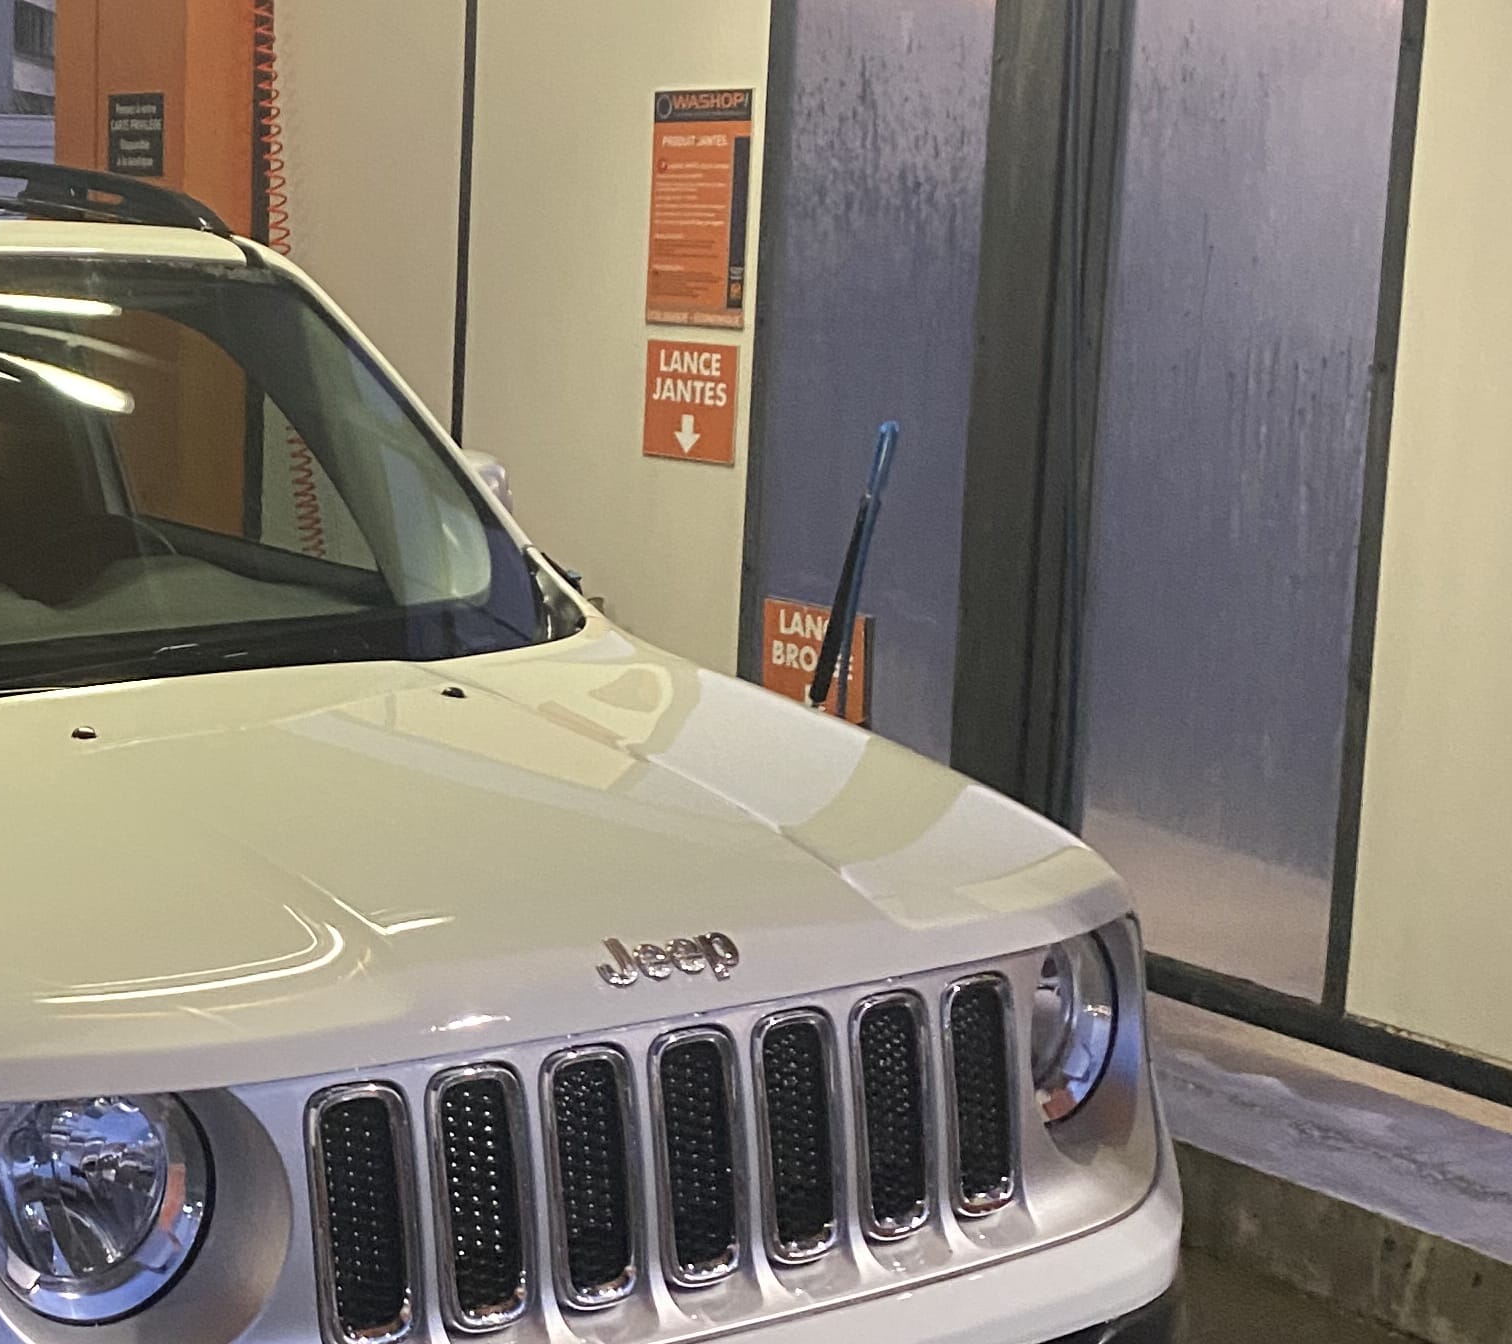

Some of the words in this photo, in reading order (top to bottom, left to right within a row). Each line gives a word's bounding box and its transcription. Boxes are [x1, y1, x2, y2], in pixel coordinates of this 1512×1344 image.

[659, 349, 722, 376] LANCE
[652, 377, 728, 407] JANTES
[780, 608, 830, 642] LAN
[595, 932, 740, 988] Jeep
